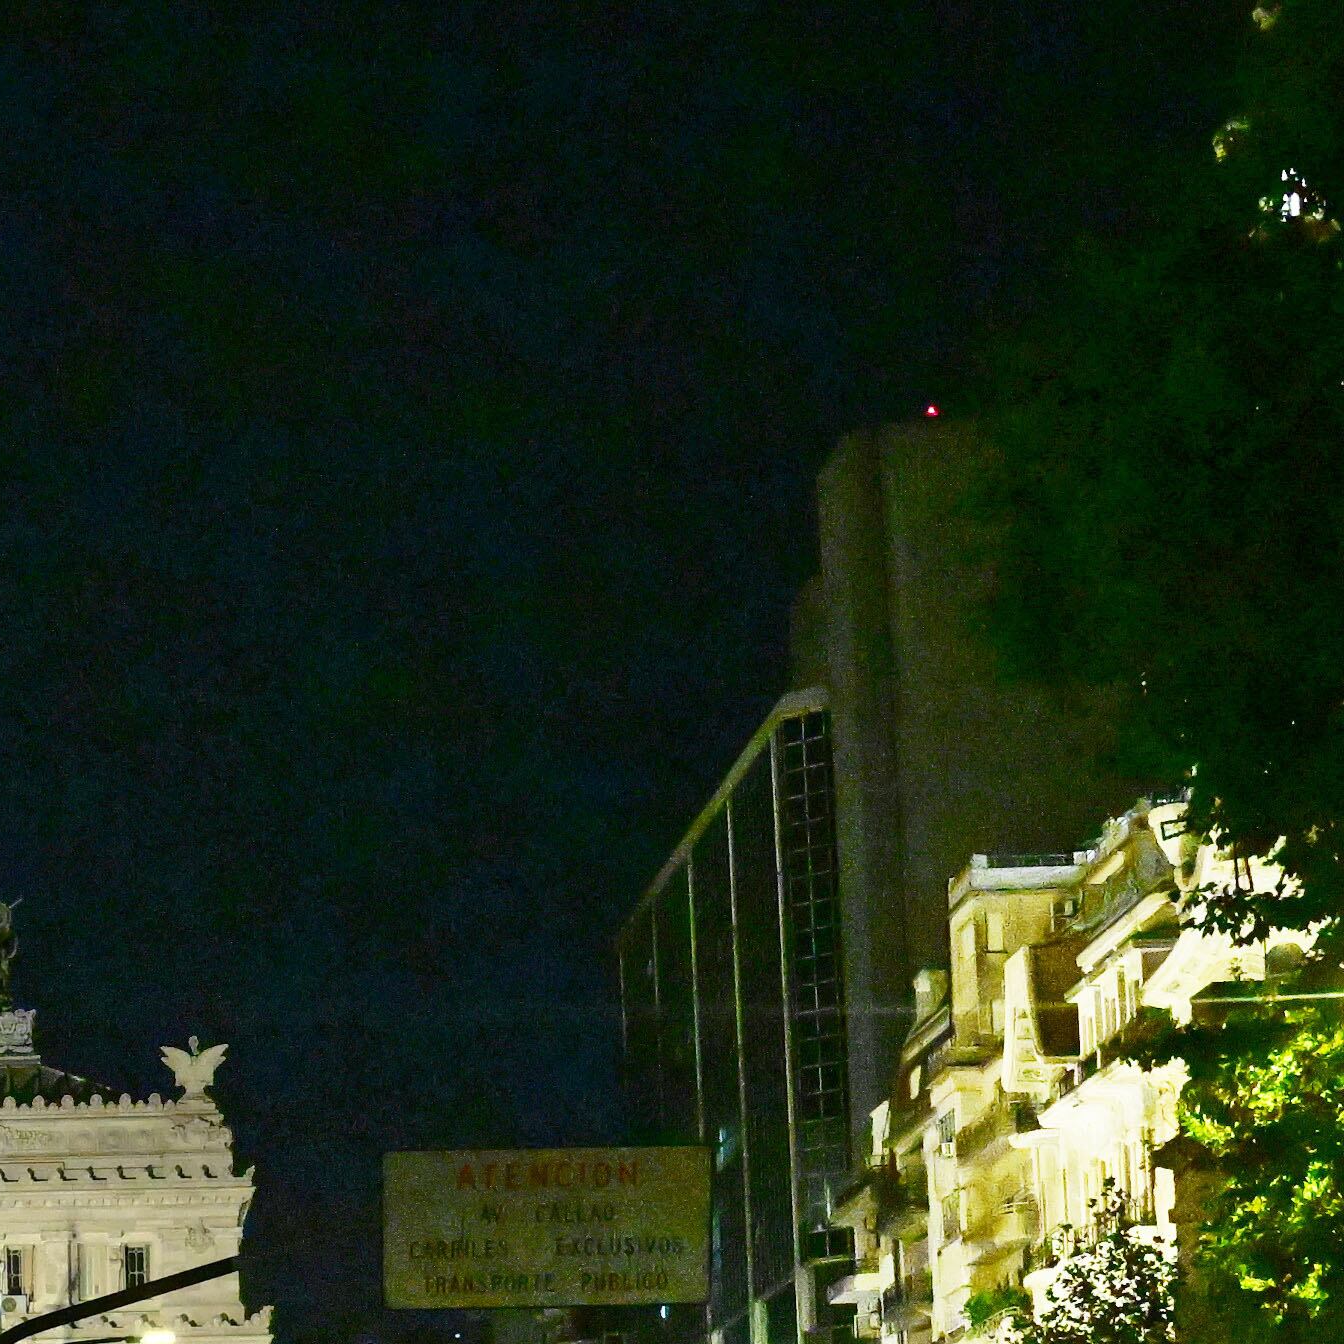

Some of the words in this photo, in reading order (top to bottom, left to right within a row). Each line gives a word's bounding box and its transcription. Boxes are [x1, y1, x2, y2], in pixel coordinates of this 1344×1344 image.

[456, 1162, 639, 1190] ATENCION
[535, 1203, 615, 1223] CALLAO
[409, 1238, 509, 1260] CARRILES
[556, 1236, 684, 1257] EXCLUSIVOS
[425, 1273, 555, 1295] TRANSPORTE
